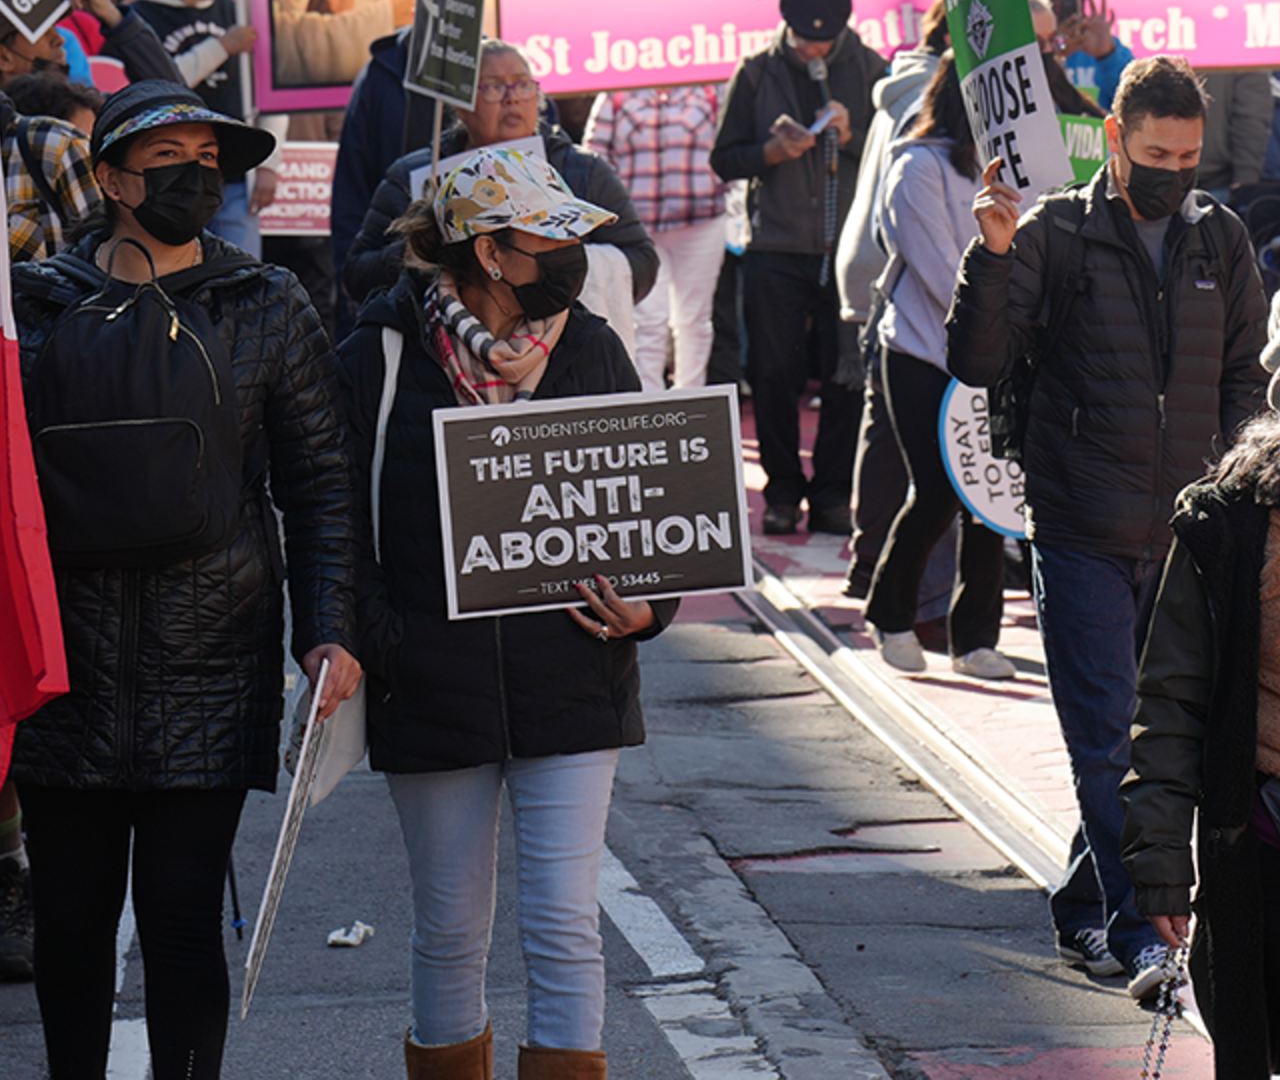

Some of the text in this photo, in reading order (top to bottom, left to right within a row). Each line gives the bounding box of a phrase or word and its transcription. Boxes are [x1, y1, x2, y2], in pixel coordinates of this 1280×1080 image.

[524, 35, 571, 78] St
[1065, 121, 1104, 162] VIDA
[512, 412, 688, 442] STUDENTSFORLIFE.ORG
[470, 436, 709, 482] THE FUTURE IS
[949, 415, 980, 487] PRAY
[520, 474, 665, 524] ANTI-
[983, 463, 1005, 504] TO
[460, 511, 733, 575] ABORTION
[540, 579, 570, 595] TEXT
[620, 571, 661, 587] 53445
